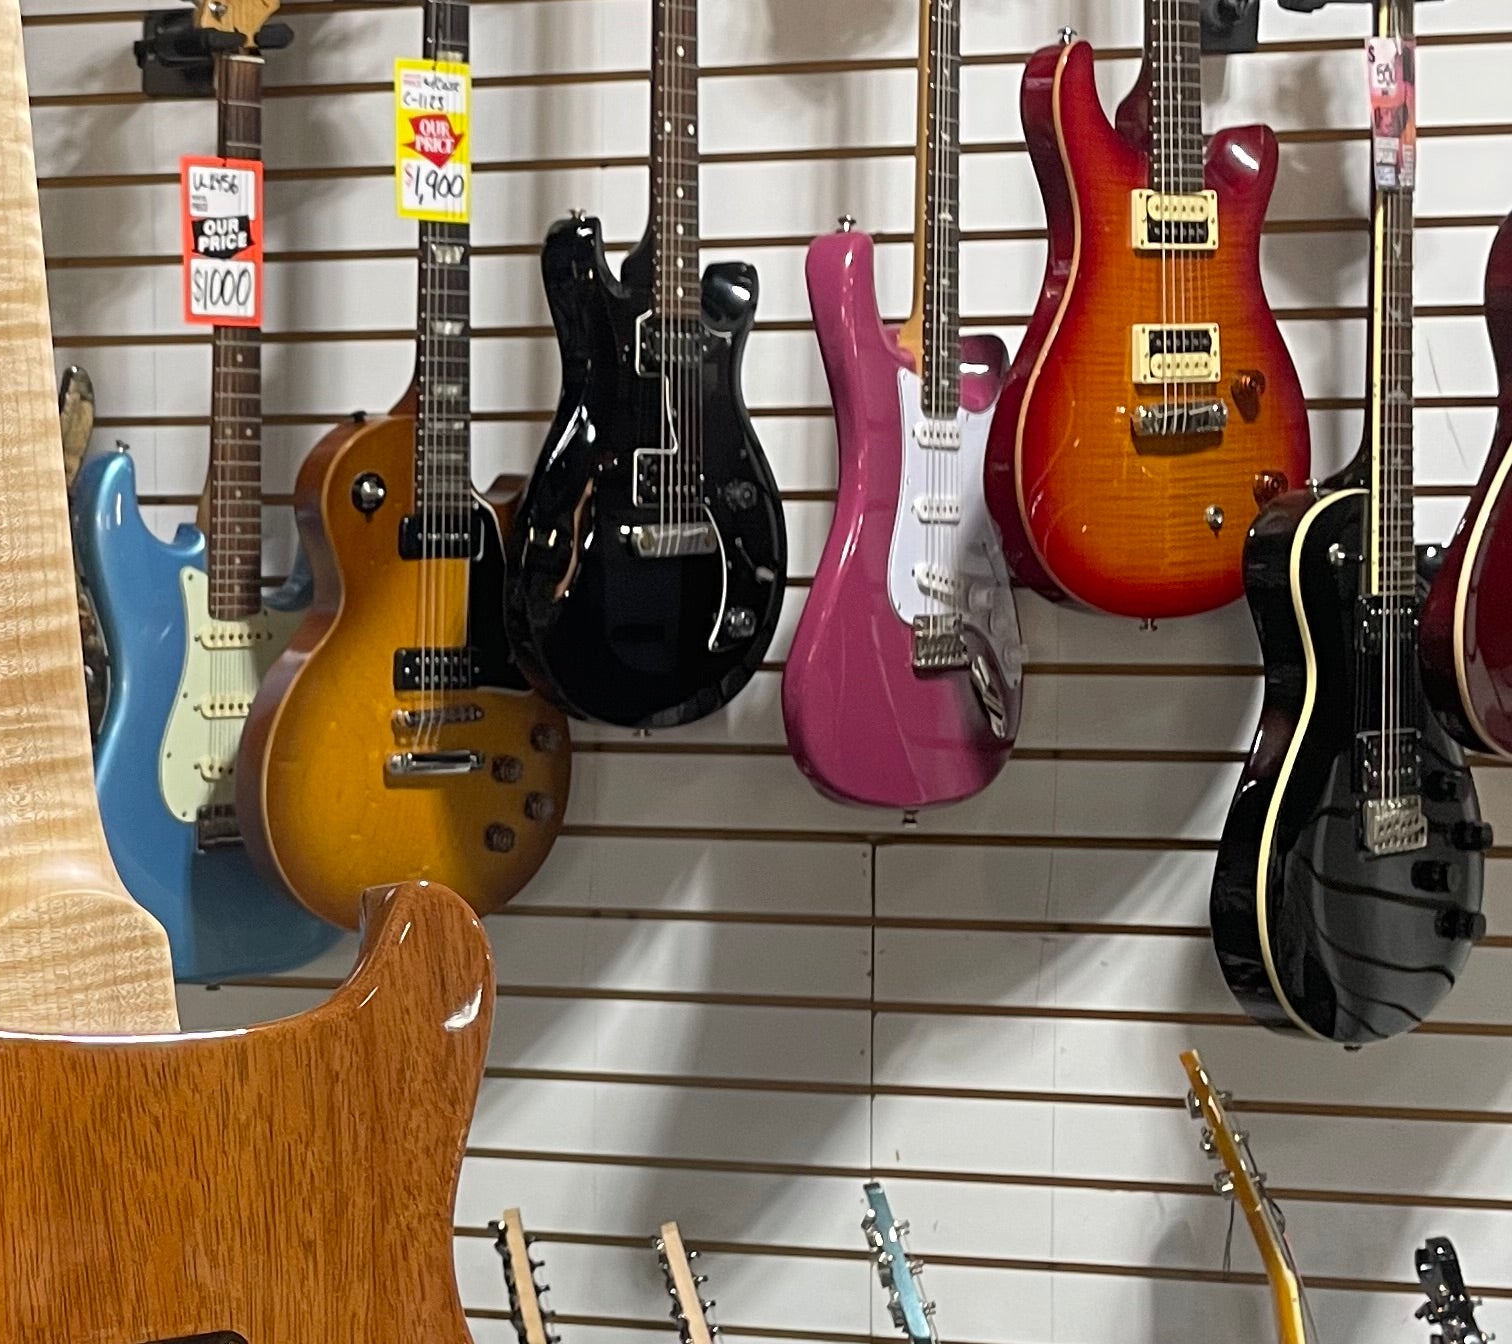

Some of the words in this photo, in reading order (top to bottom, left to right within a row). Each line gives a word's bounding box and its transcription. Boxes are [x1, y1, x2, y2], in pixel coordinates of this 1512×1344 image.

[418, 118, 451, 138] OUR
[414, 136, 455, 155] PRICE
[202, 217, 240, 236] OUR
[197, 230, 248, 253] PRICE
[193, 267, 252, 311] $1000
